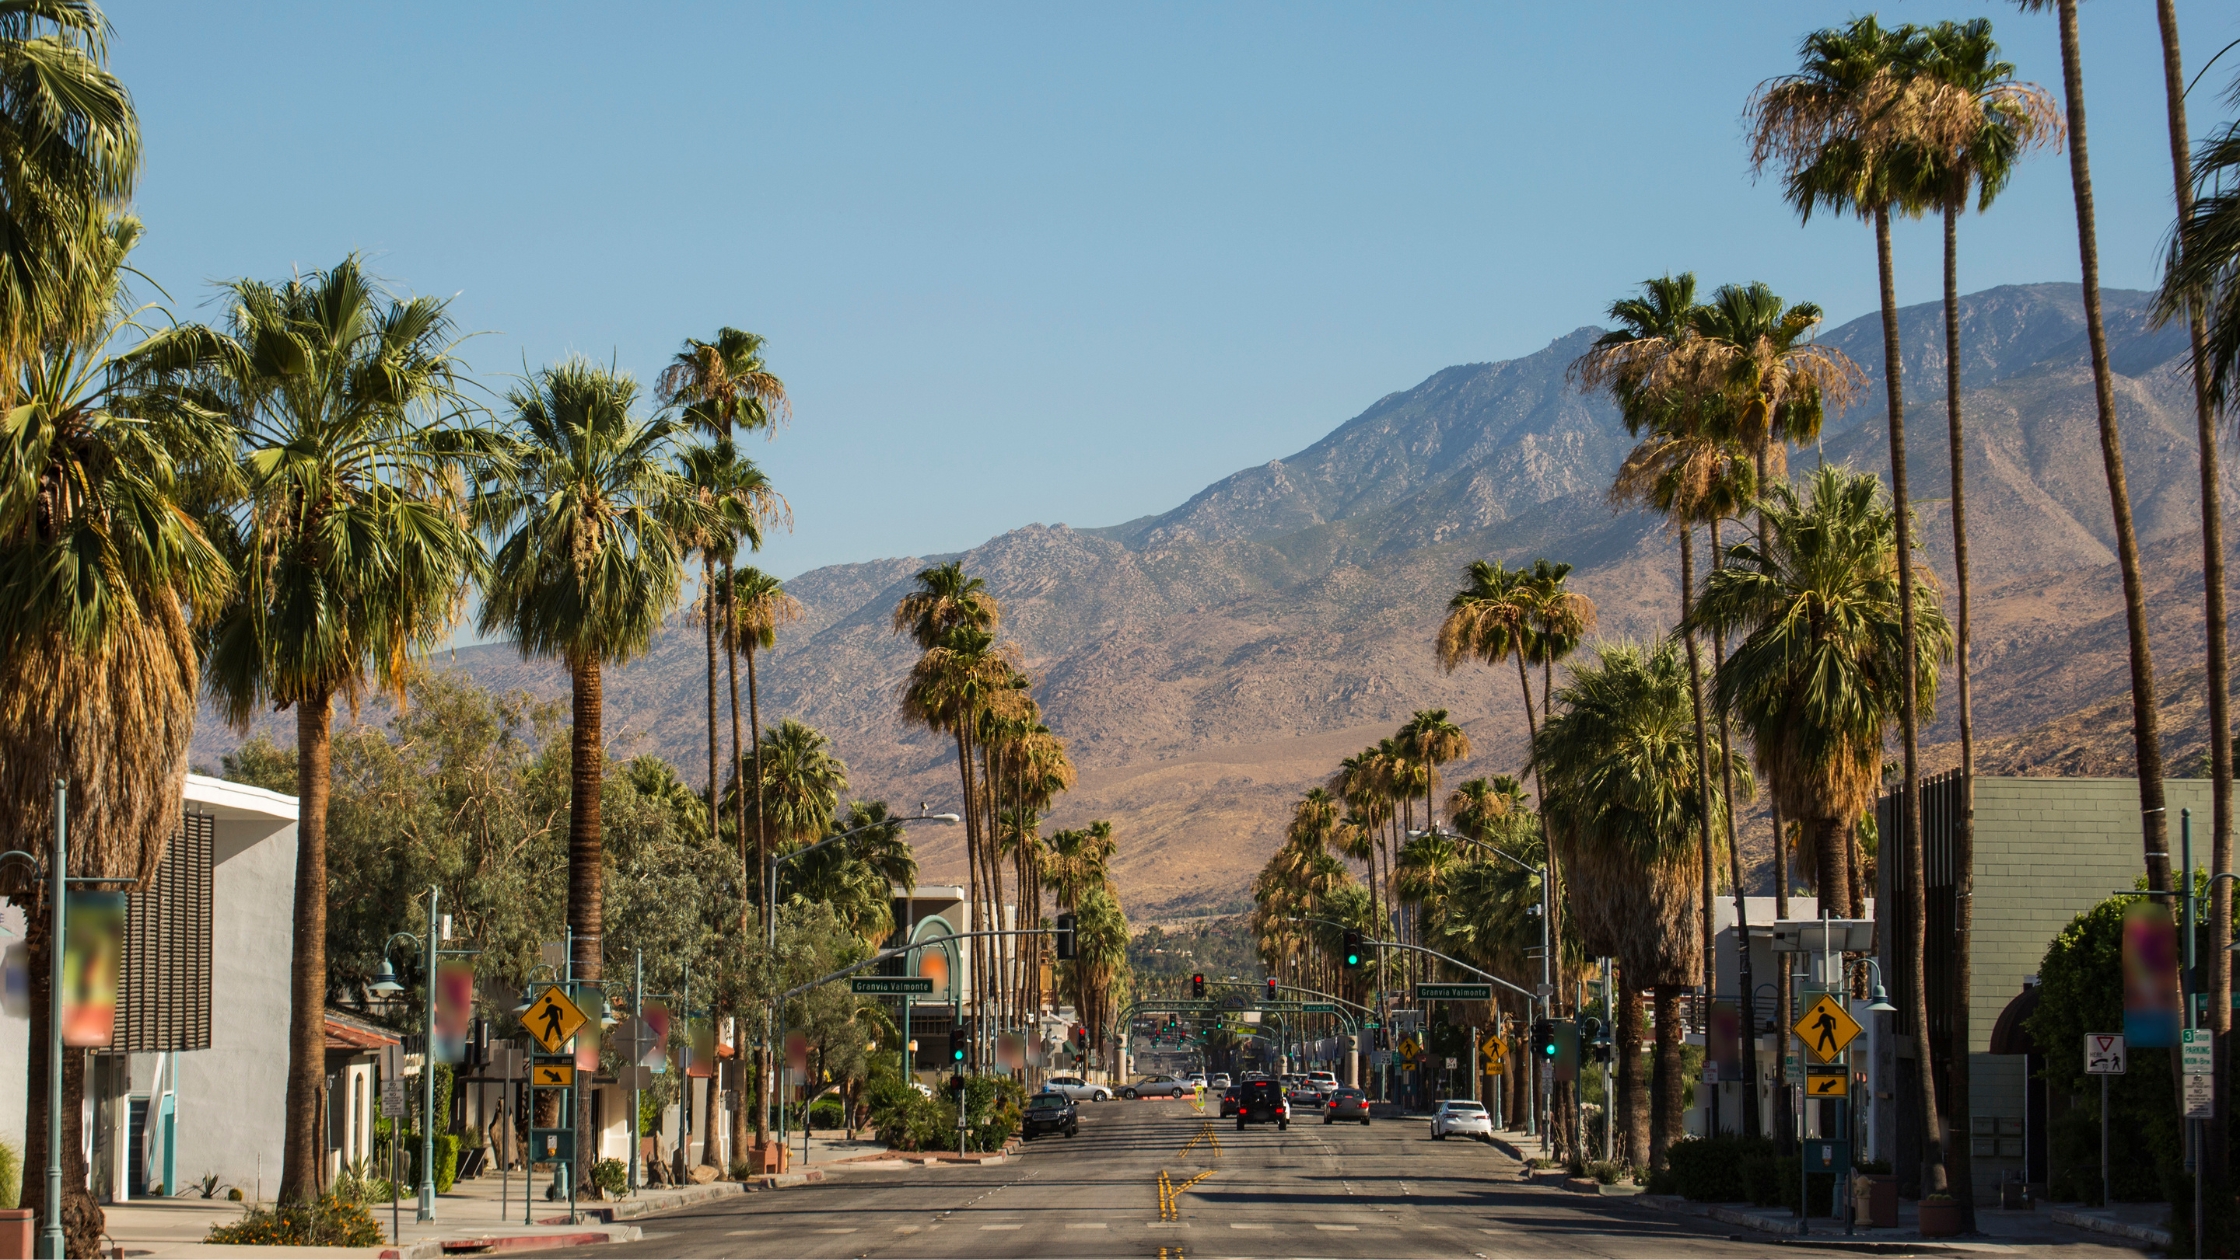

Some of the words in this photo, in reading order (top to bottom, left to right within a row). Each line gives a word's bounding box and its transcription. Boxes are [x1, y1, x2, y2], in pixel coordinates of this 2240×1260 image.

[856, 982, 888, 991] Granvia
[890, 982, 929, 991] Valmonte
[1421, 988, 1450, 997] Granvia
[1452, 988, 1487, 997] Valmonte
[2184, 1031, 2192, 1042] 3
[2194, 1033, 2209, 1041] HOUR
[2185, 1046, 2210, 1054] PARKING
